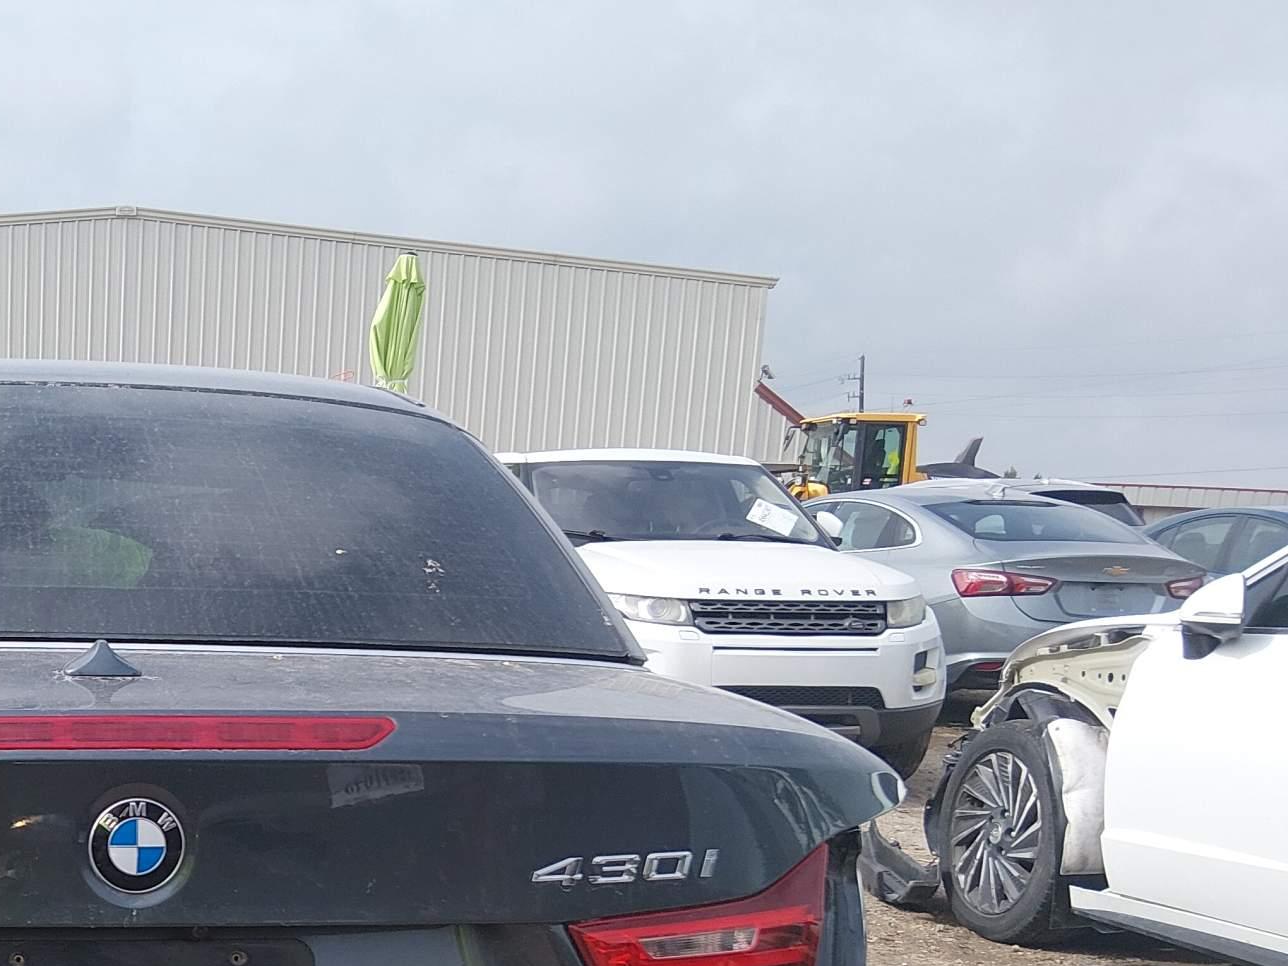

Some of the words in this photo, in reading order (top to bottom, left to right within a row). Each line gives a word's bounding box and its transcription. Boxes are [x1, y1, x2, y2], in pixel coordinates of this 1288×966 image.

[699, 587, 782, 596] RANGE
[801, 589, 877, 597] ROVER
[99, 802, 177, 832] BMW
